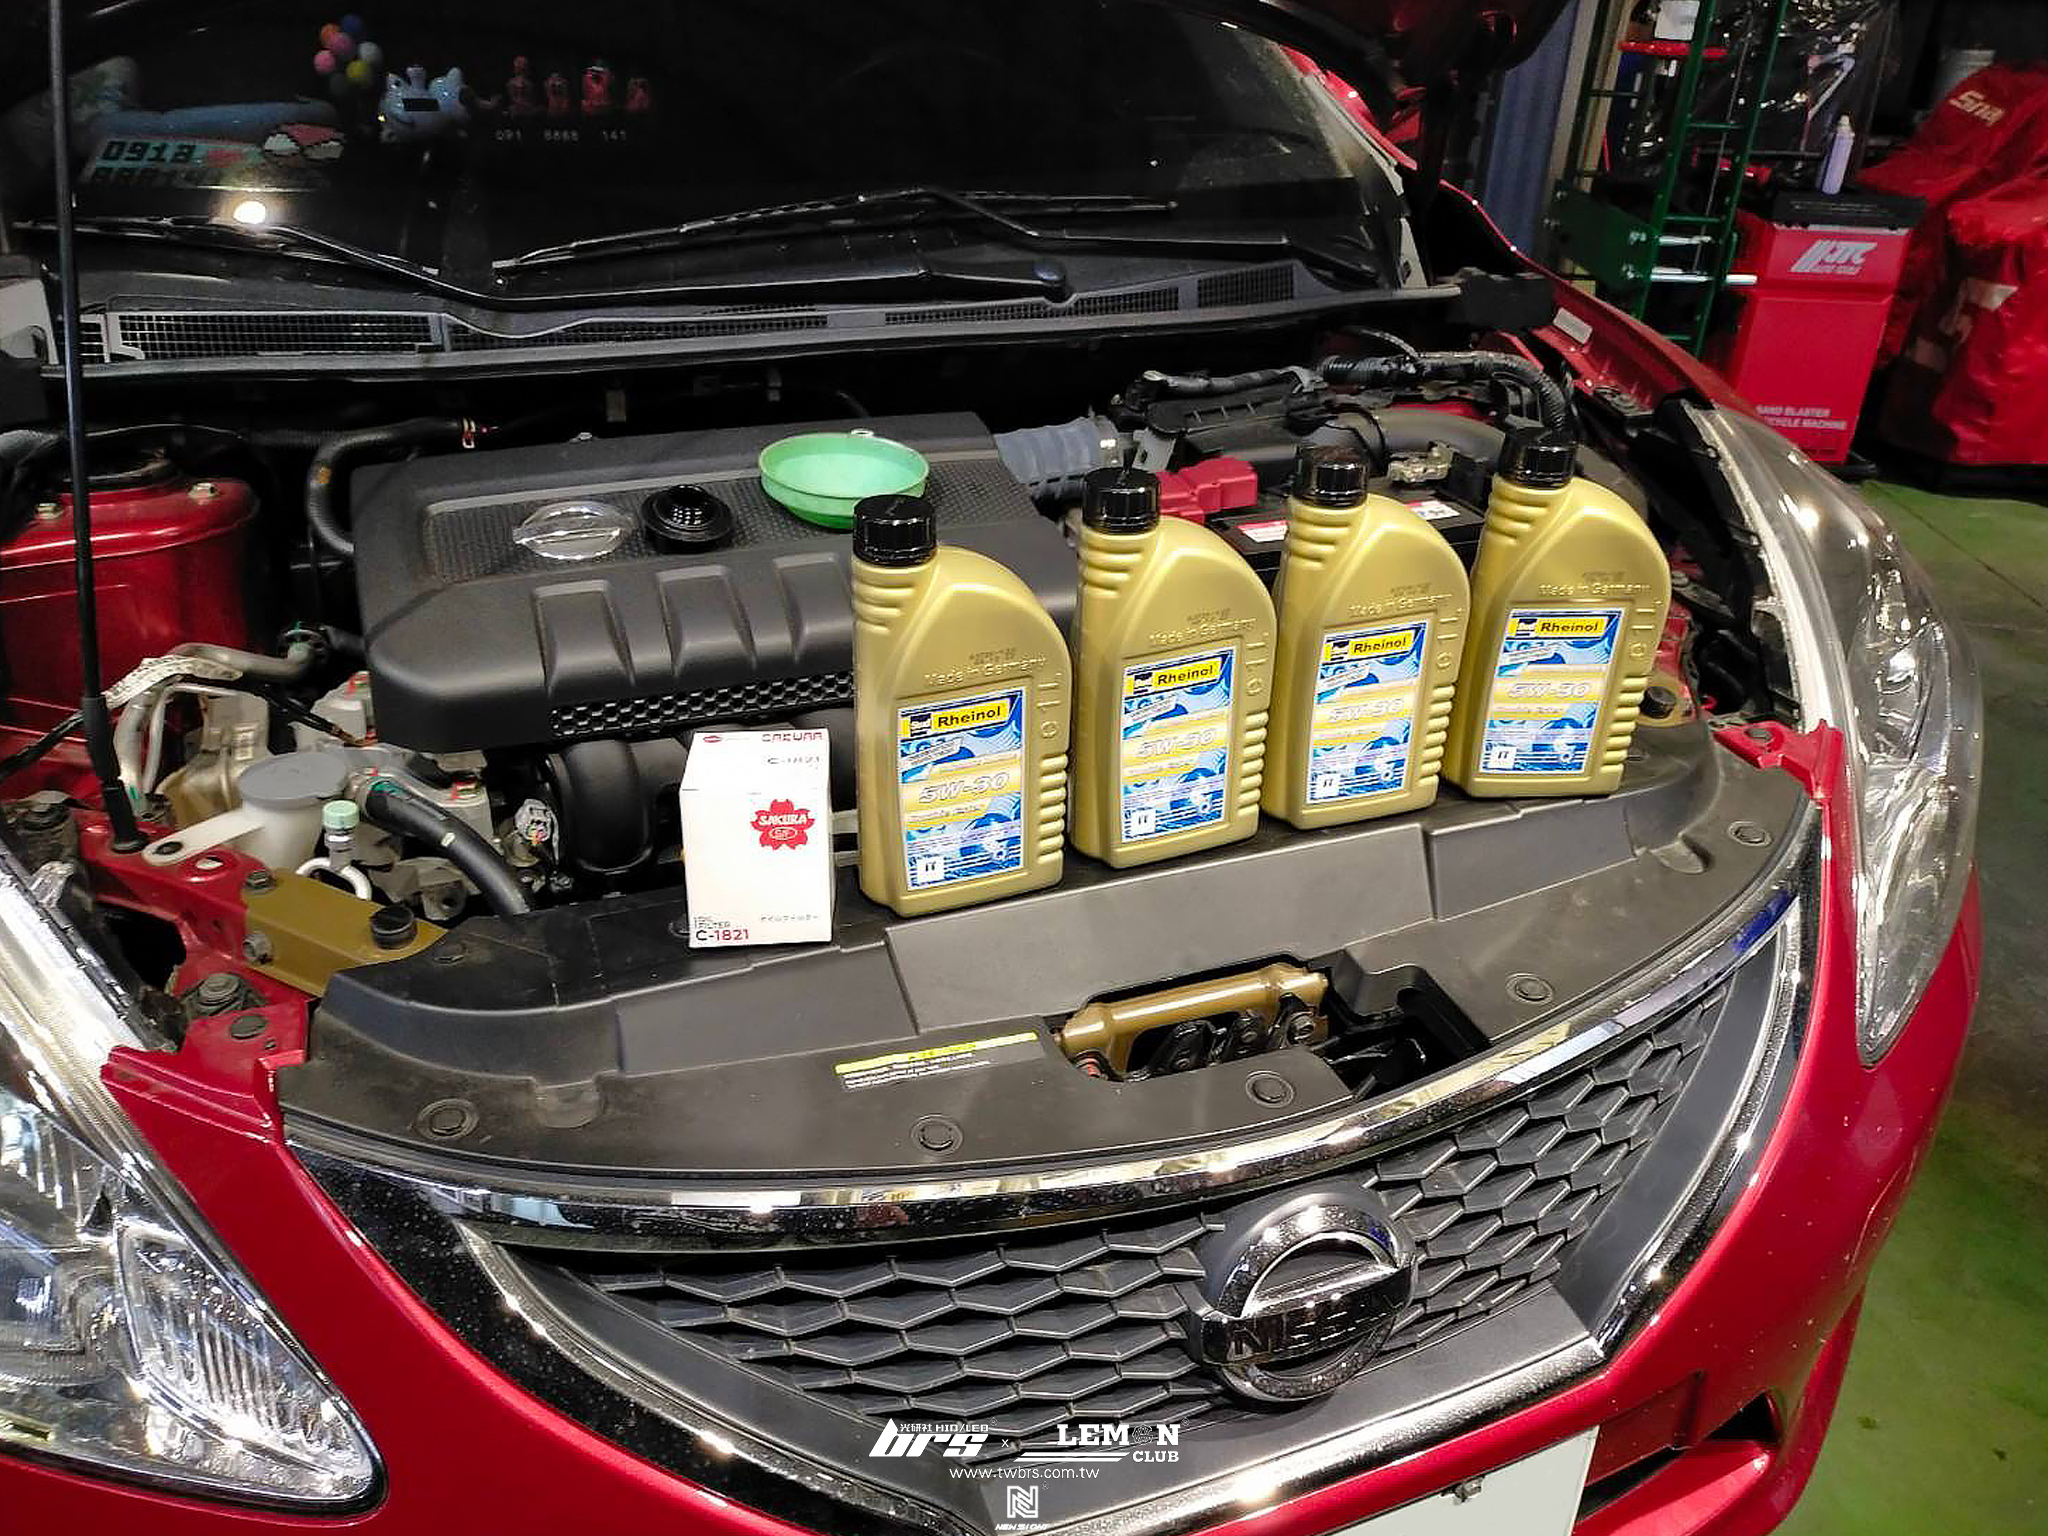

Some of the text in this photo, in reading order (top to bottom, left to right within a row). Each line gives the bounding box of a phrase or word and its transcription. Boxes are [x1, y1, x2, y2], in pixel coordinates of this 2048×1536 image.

[1539, 621, 1599, 634] Rheinol
[1353, 637, 1406, 654] Rheinol
[1157, 665, 1213, 686] Rheinol
[1508, 682, 1591, 698] 5W-30
[936, 705, 1001, 728] Rheinol
[919, 771, 1010, 804] 5W-30
[758, 813, 807, 827] SAKURA
[695, 929, 750, 942] C-1821
